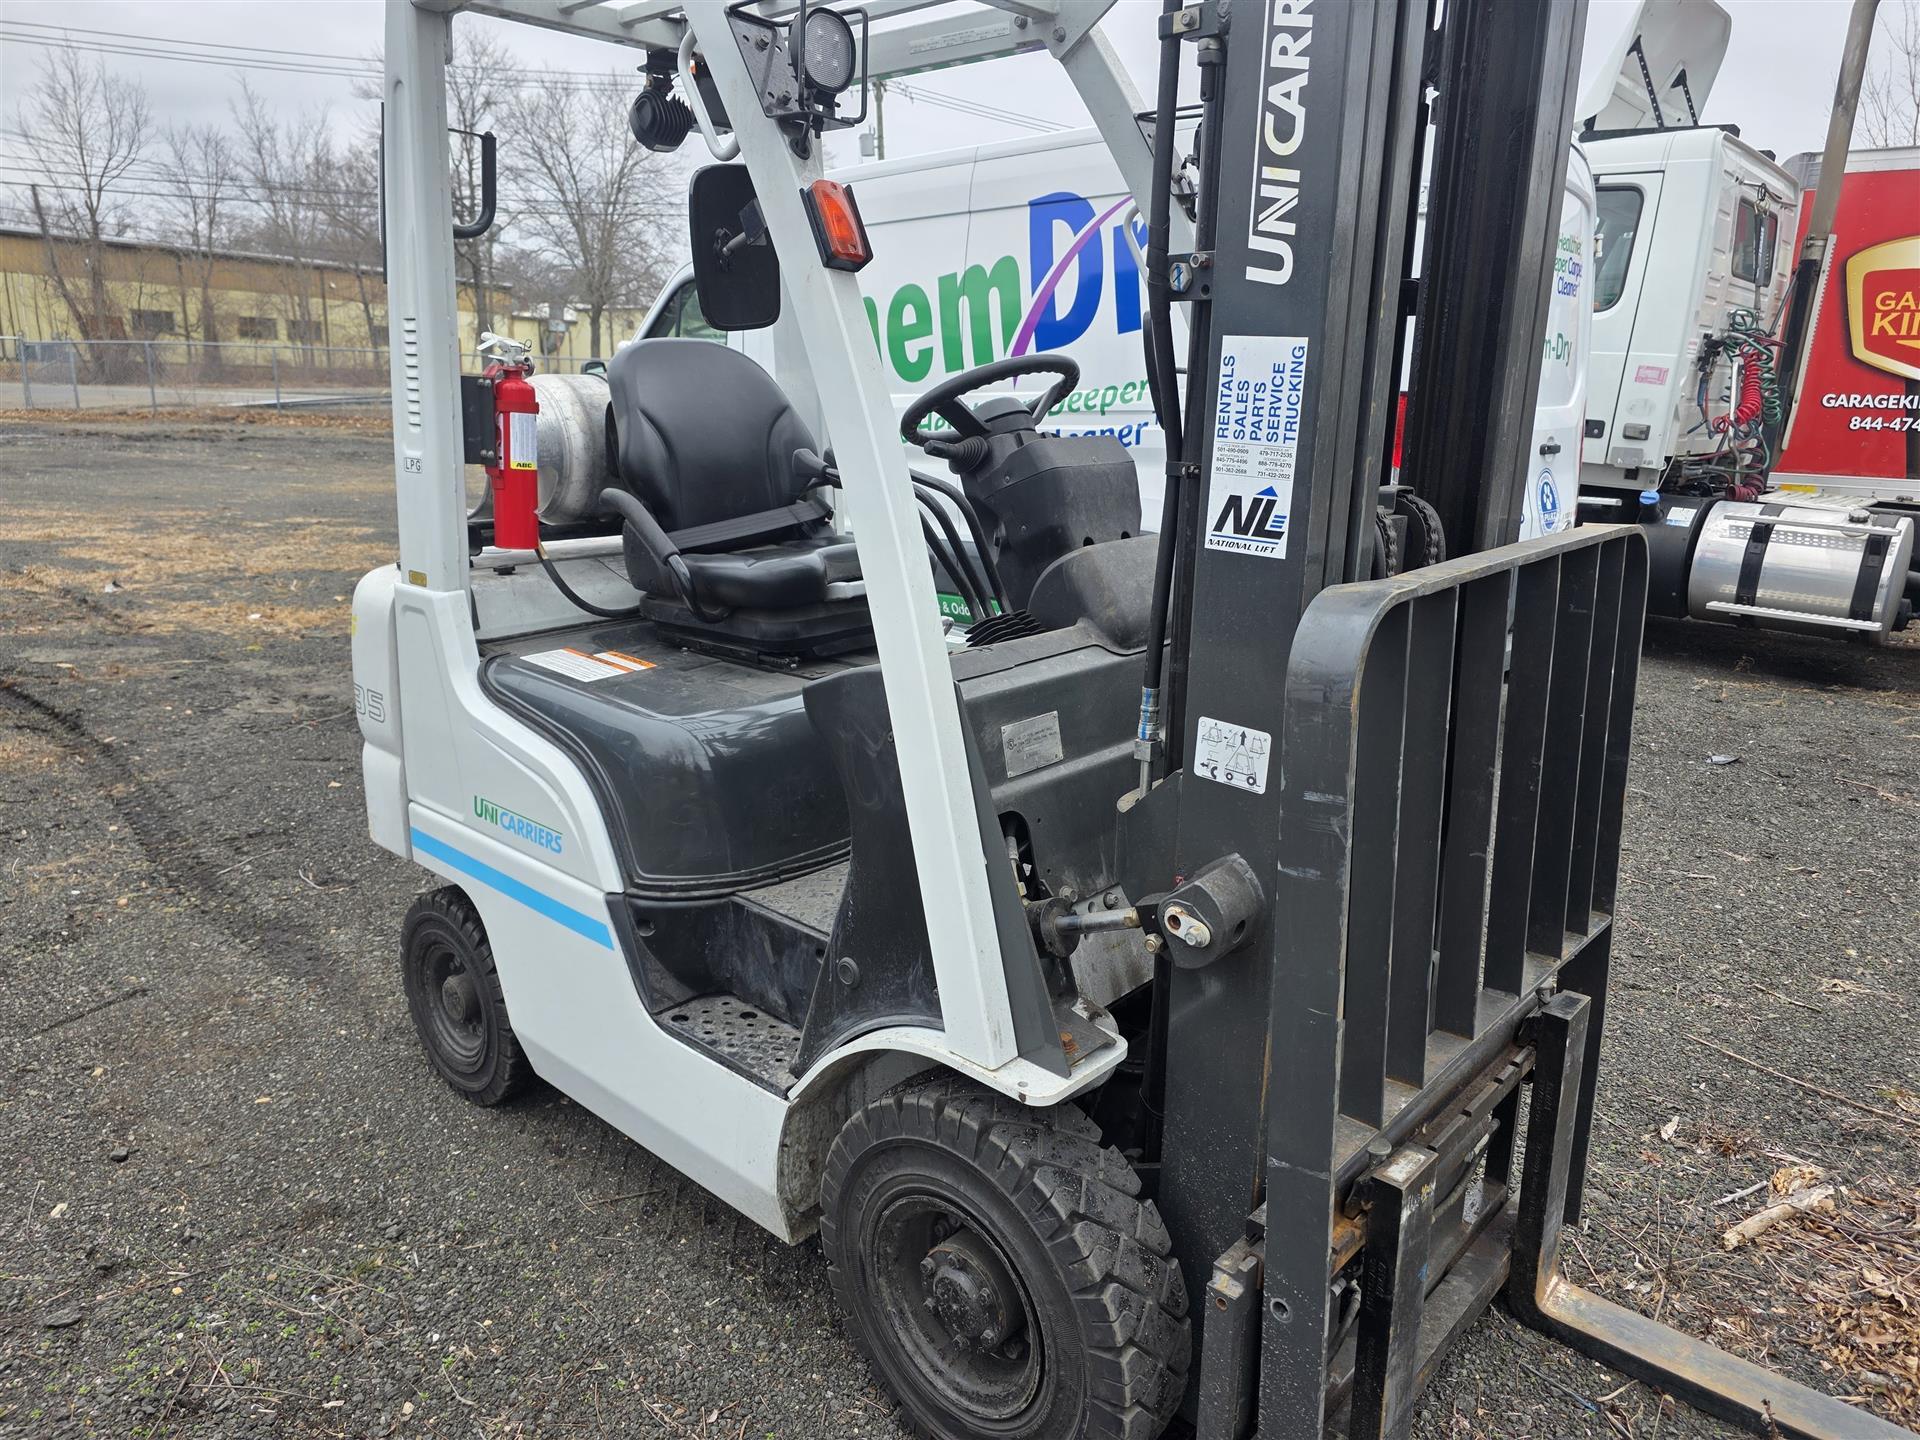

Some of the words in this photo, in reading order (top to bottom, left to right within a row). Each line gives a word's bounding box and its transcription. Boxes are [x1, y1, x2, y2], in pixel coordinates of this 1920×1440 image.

[1875, 291, 1920, 311] GA
[1217, 355, 1236, 439] RENTALS
[1233, 380, 1250, 440] SALES
[1250, 382, 1267, 441] PARTS
[1266, 362, 1286, 443] SERVICE
[1283, 345, 1306, 444] TRUCKING
[1822, 393, 1920, 410] GARAGEKI
[405, 459, 421, 471] LPG
[1259, 450, 1293, 459] 479-717-2535
[1257, 470, 1291, 479] 731-422-2022
[1207, 538, 1252, 551] NATIONAL
[1254, 544, 1277, 554] LIFT
[473, 795, 563, 854] UNICARRIERS
